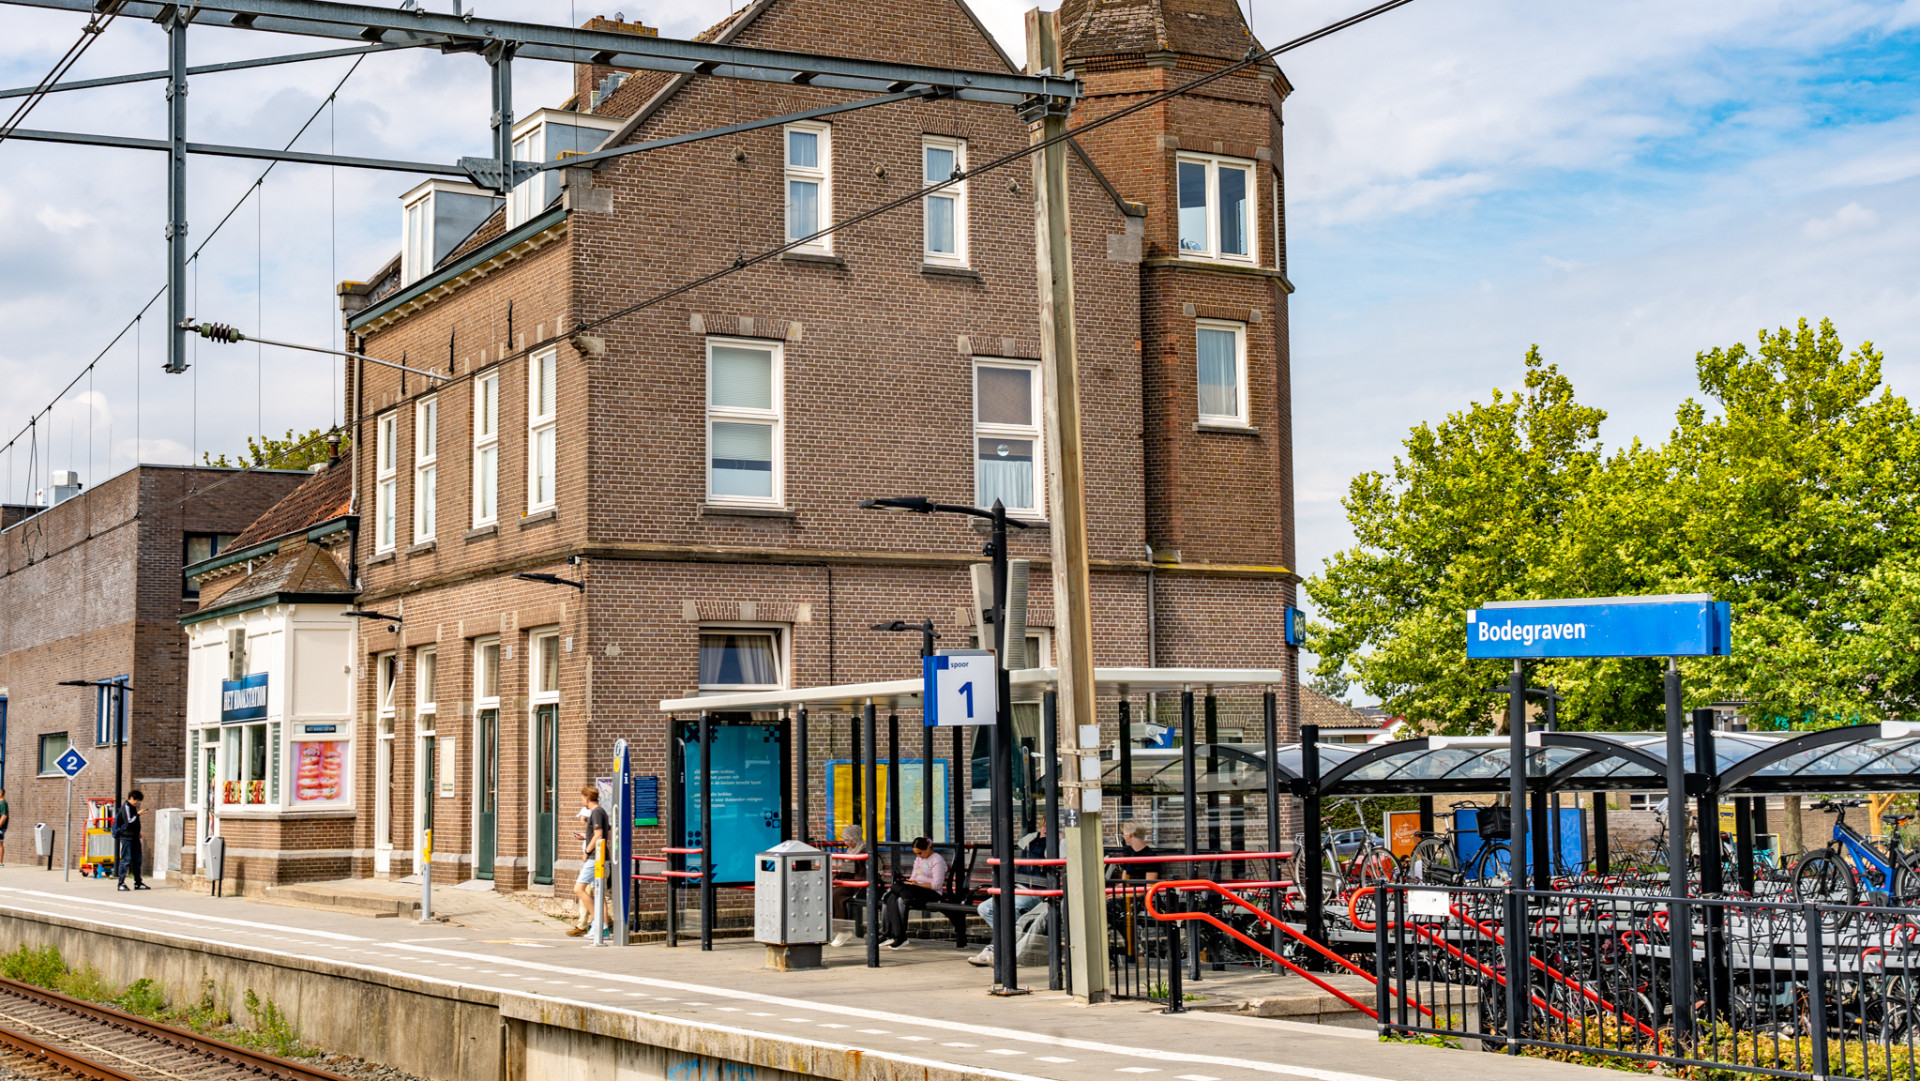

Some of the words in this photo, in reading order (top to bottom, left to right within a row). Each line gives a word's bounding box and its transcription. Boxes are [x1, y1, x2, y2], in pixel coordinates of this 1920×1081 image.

[1478, 619, 1586, 646] Bodegraven
[950, 661, 969, 669] spoor
[223, 690, 234, 712] HET
[958, 681, 974, 718] 1
[66, 755, 78, 770] 2
